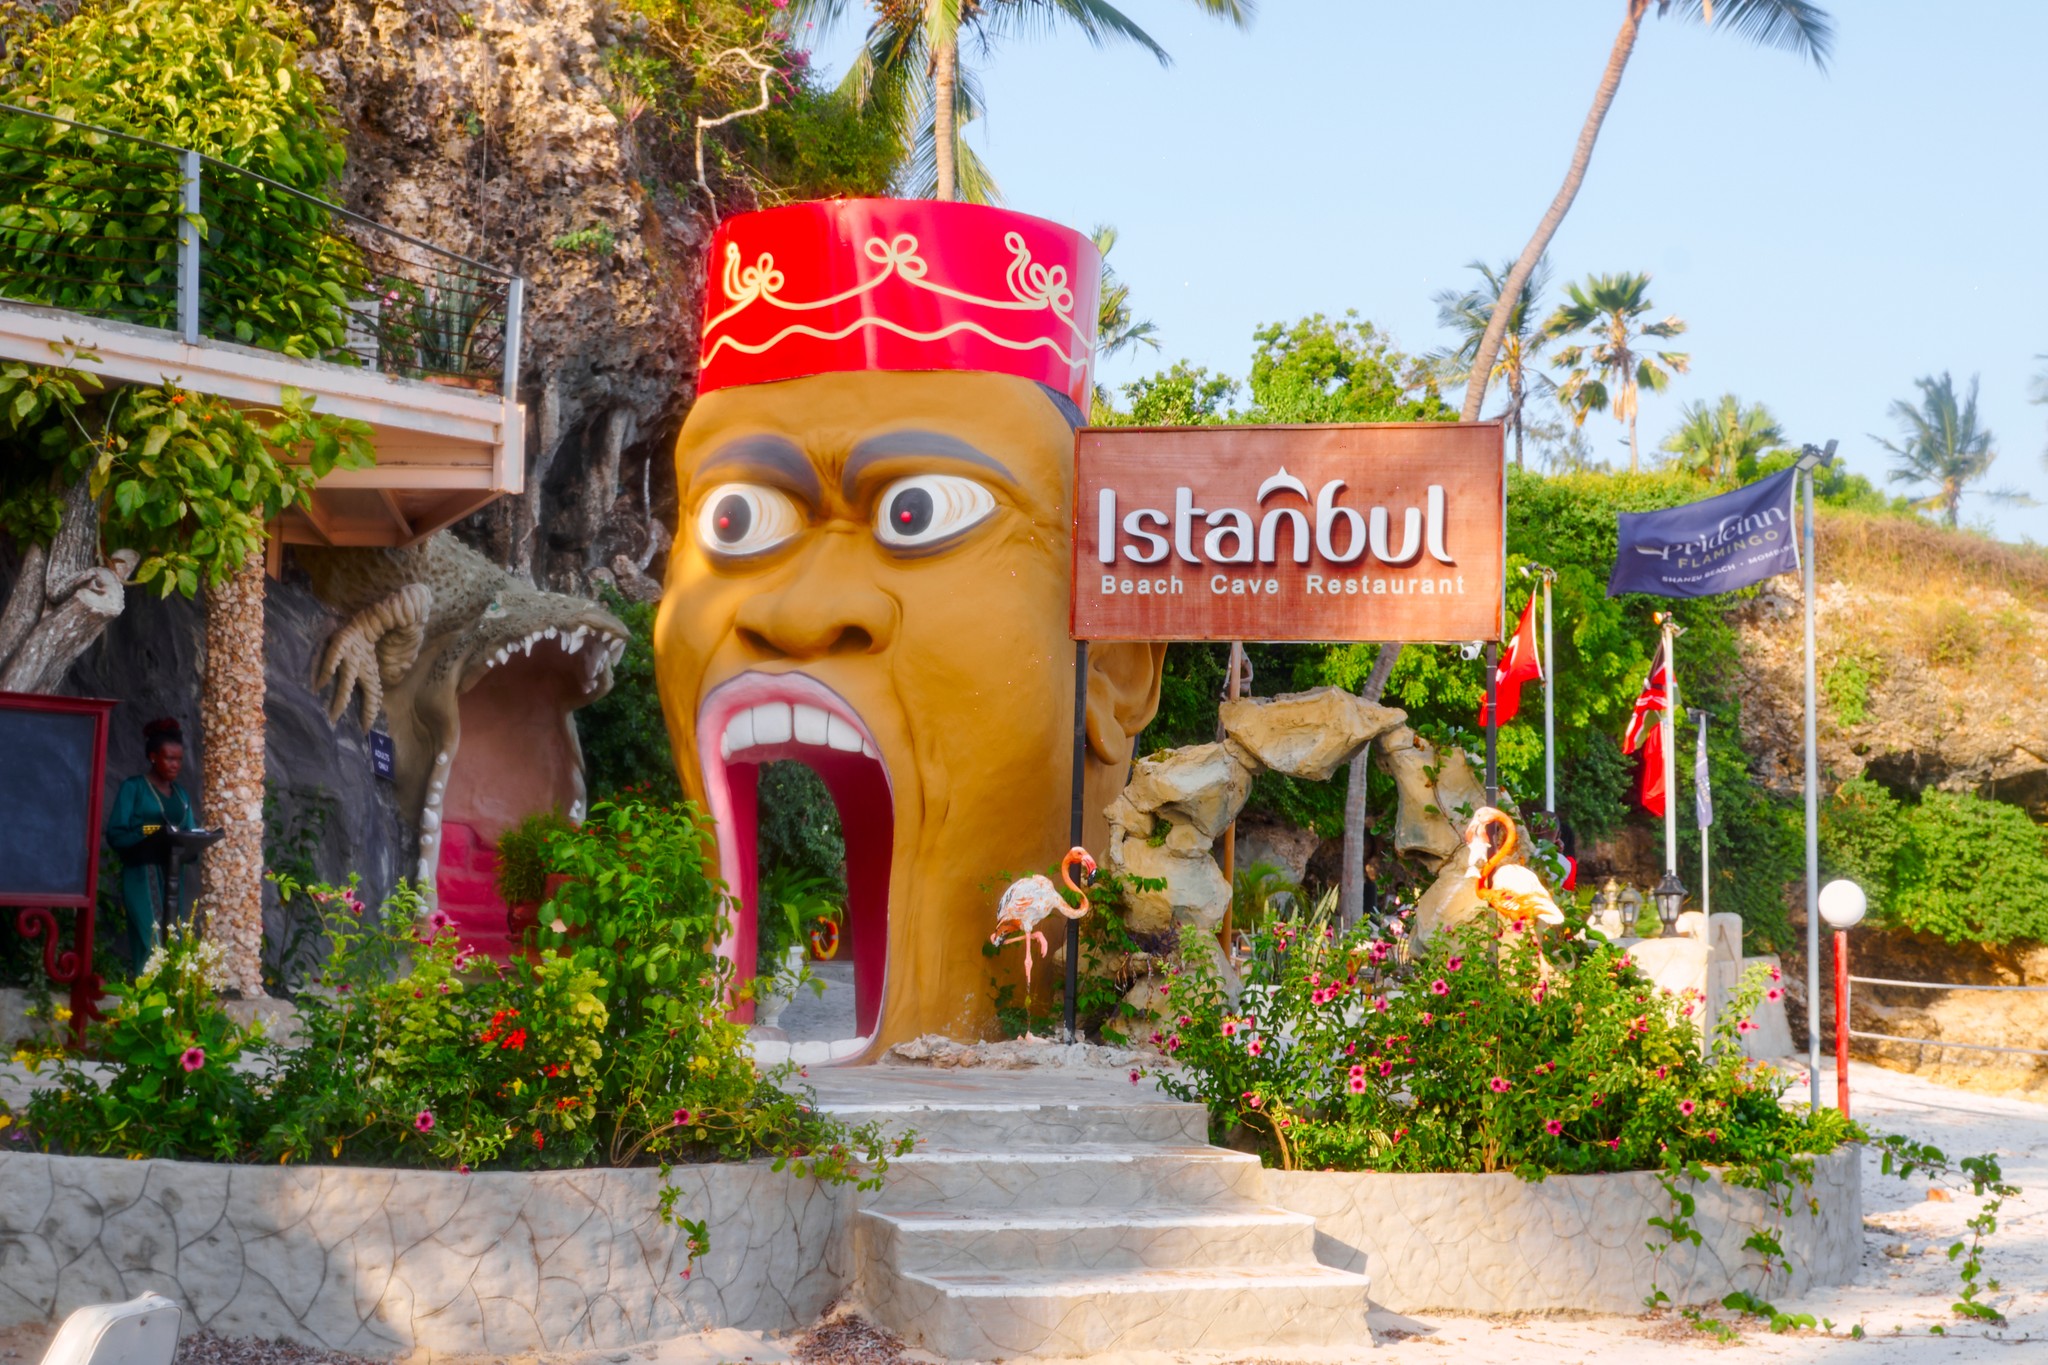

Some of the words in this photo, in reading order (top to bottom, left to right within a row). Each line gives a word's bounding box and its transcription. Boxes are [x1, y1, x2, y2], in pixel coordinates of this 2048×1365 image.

[1098, 467, 1455, 564] Istanbul
[1677, 530, 1779, 569] FLAMINGO
[1661, 575, 1702, 584] SHANZU
[1704, 563, 1736, 578] BEACH
[1100, 574, 1184, 595] Beach
[1210, 574, 1280, 595] Cave
[1306, 574, 1466, 595] Restaurant
[374, 749, 390, 762] ADULTS
[378, 761, 389, 772] ONLY
